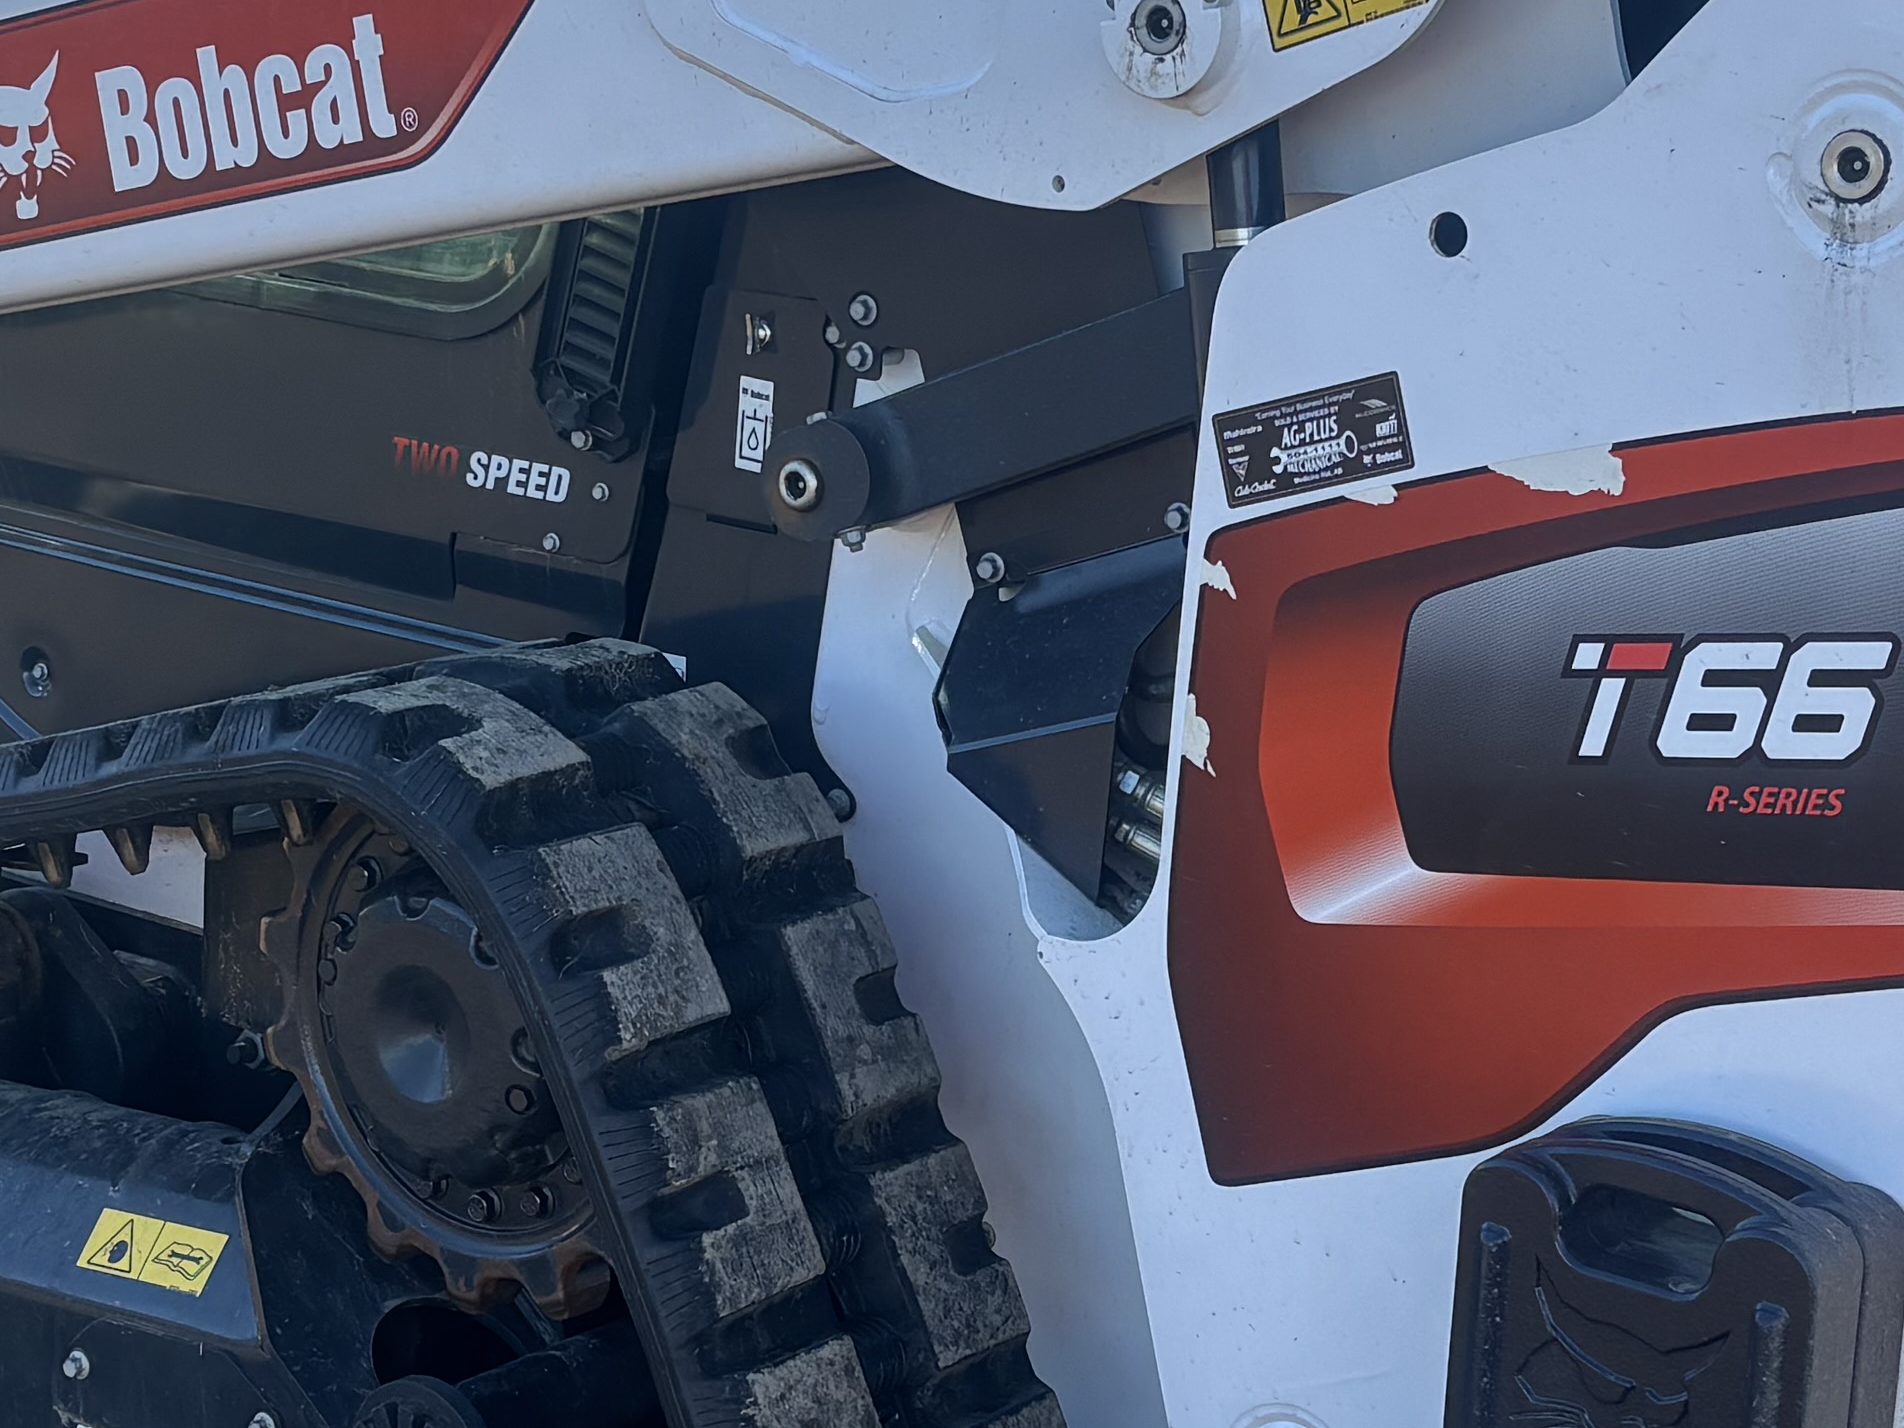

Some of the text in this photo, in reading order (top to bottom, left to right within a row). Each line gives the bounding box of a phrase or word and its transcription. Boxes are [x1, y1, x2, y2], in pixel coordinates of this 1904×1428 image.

[94, 12, 399, 193] Bobcat
[1281, 416, 1338, 448] AG-PLUS
[393, 435, 571, 503] TWO SPEED
[1571, 642, 1893, 760] T66
[1706, 785, 1846, 816] R-SERIES
